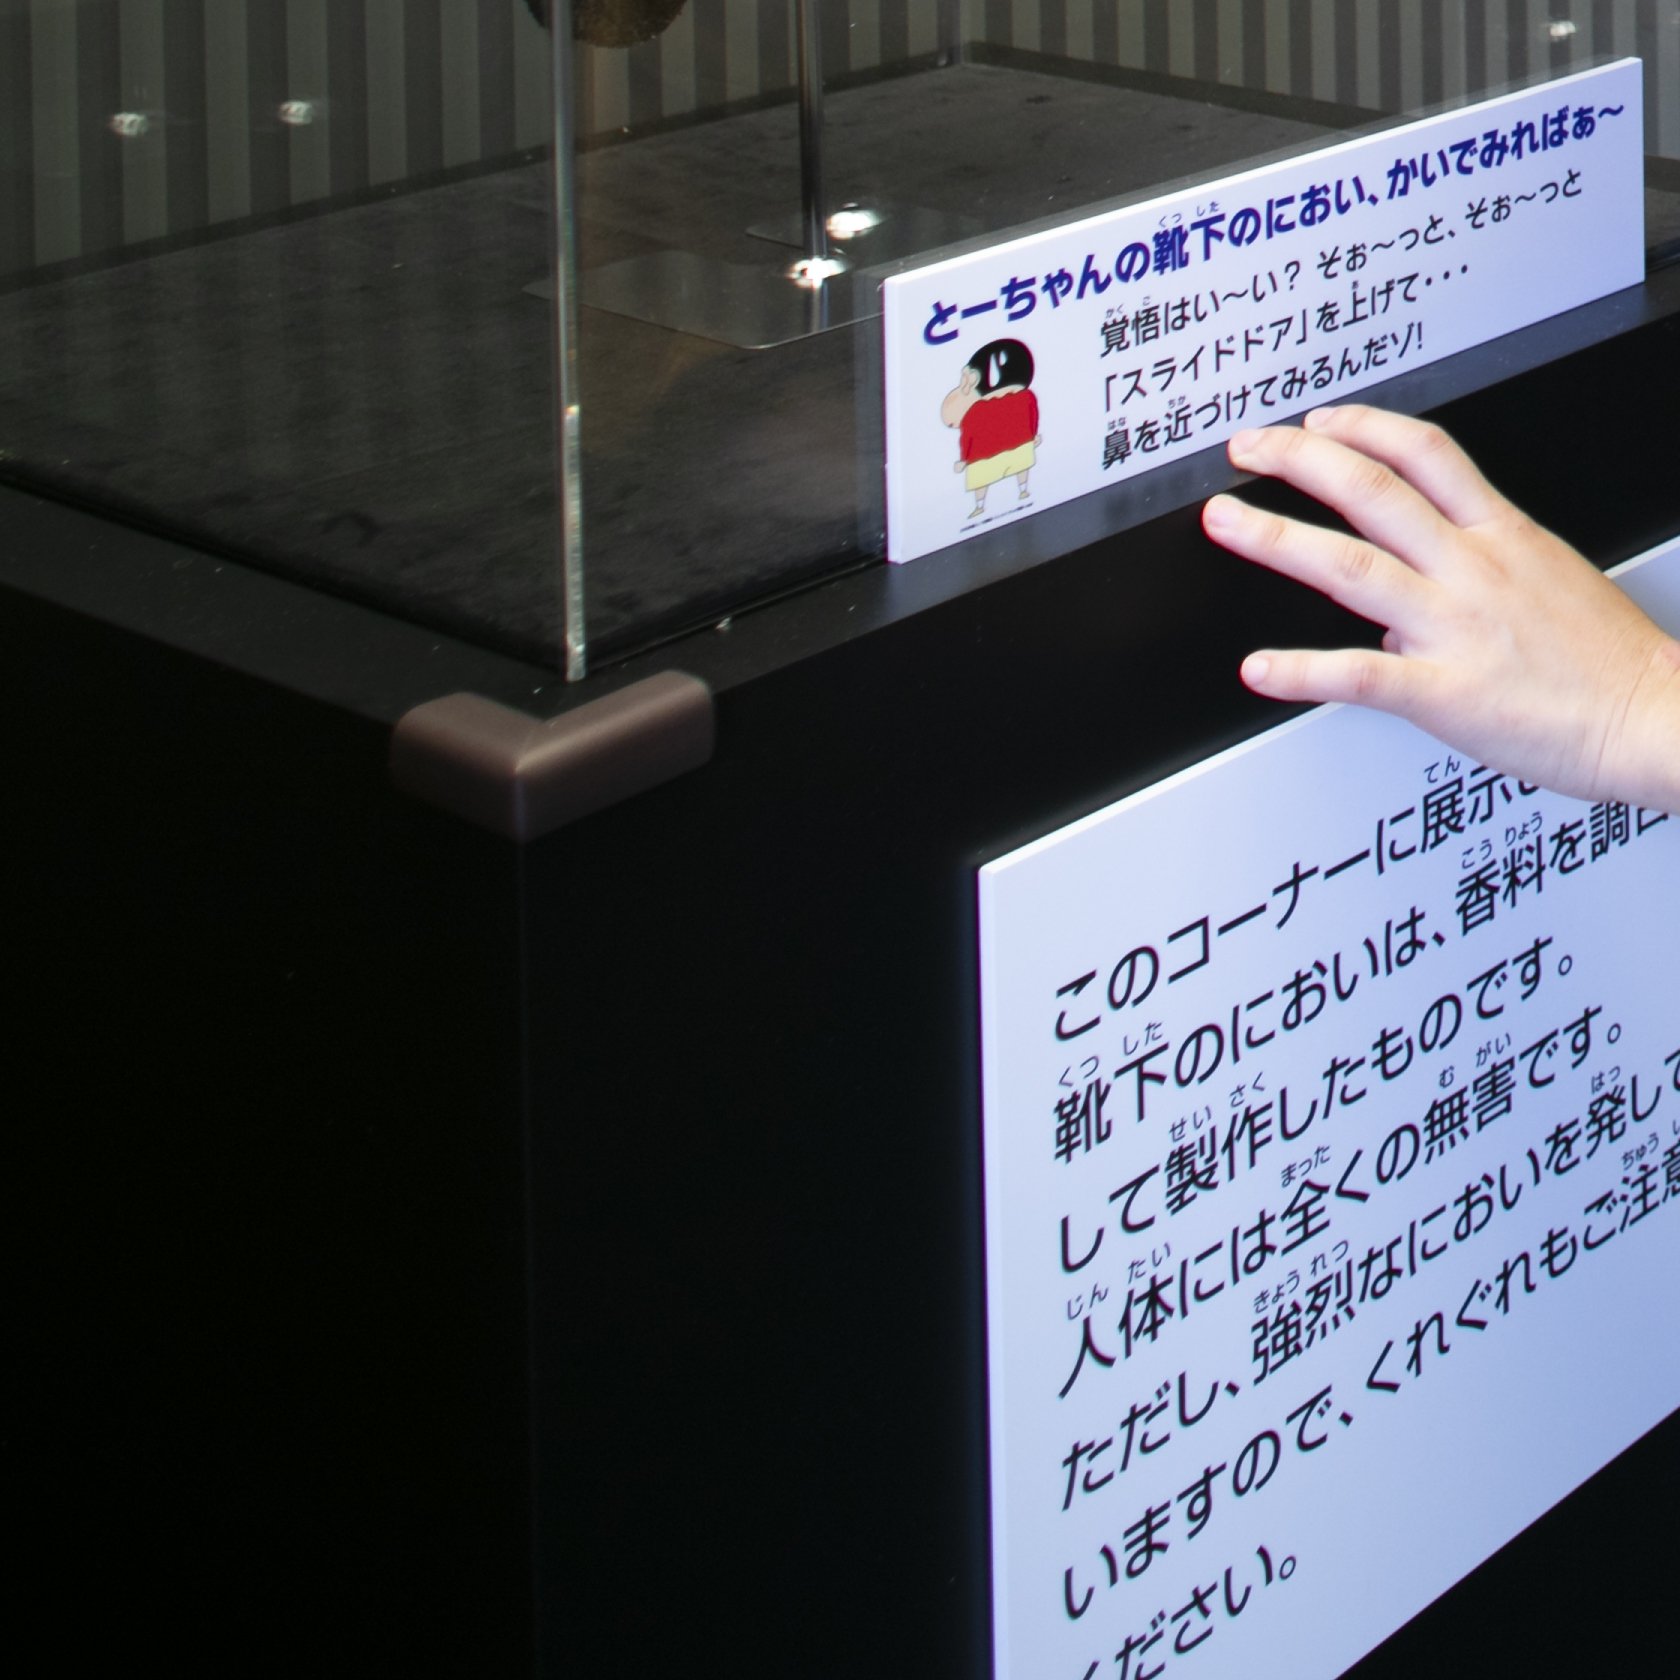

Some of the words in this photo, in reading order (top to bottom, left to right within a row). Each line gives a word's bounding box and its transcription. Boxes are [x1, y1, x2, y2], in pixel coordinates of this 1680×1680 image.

[1102, 322, 1422, 470] 鼻を近づけてみるんだゾ！
[1424, 755, 1460, 784] てん
[1059, 1056, 1099, 1087] くつ
[1124, 1023, 1162, 1056] した
[1462, 839, 1492, 869] こう
[1505, 811, 1542, 847] りょう
[1060, 936, 1573, 1274] して製作したものです。
[1067, 1283, 1108, 1320] じん
[1128, 1243, 1170, 1284] たい
[1281, 1146, 1330, 1188] まった
[1439, 1065, 1454, 1089] む
[1476, 1033, 1511, 1068] がい
[1169, 1106, 1211, 1141] せい
[1230, 1072, 1265, 1108] さく
[1622, 1134, 1659, 1171] ちゅう
[1058, 1005, 1621, 1399] 人体には全くの無害です。
[1254, 1270, 1300, 1314] きょう
[1311, 1240, 1349, 1277] れつ
